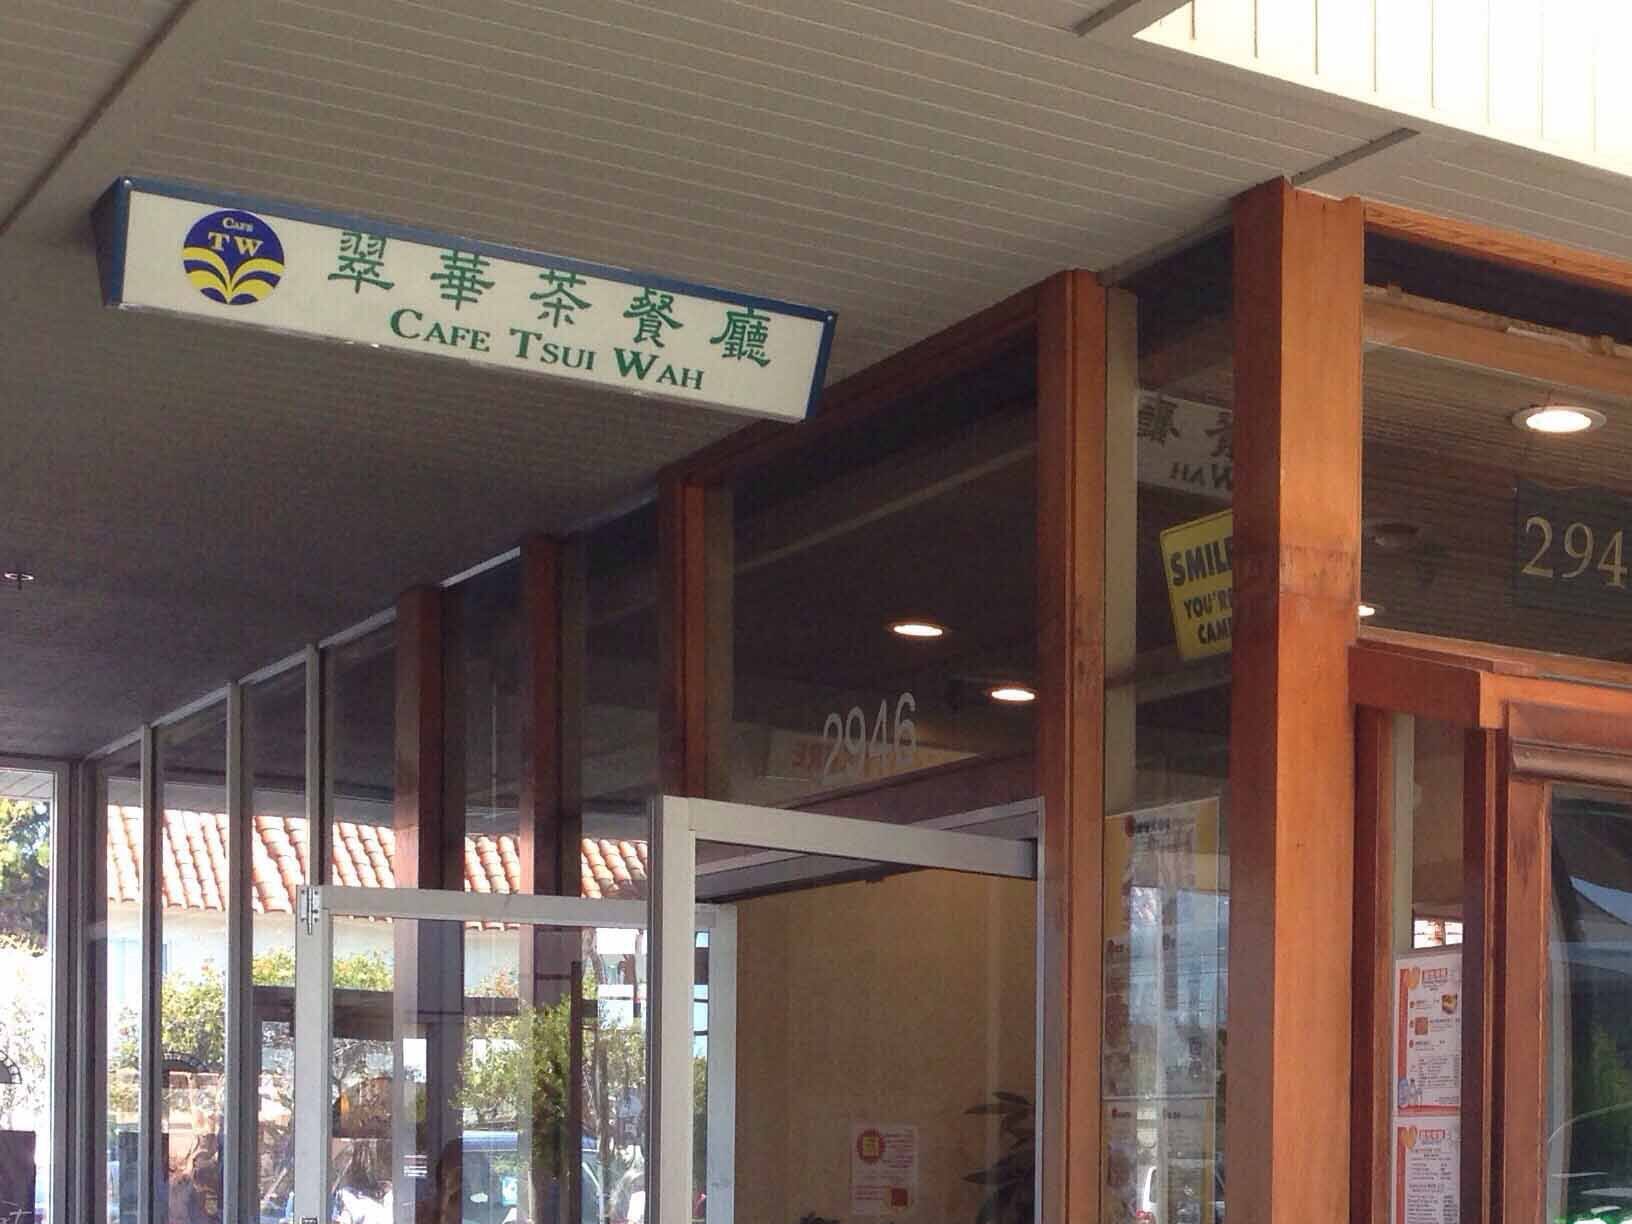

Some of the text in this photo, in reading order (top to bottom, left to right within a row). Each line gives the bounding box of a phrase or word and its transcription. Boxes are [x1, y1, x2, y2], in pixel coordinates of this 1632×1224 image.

[208, 231, 264, 257] TW
[328, 231, 771, 368] 翠華茶餐廳
[390, 308, 705, 391] CAFE TSUI WAH
[823, 692, 917, 776] 2946
